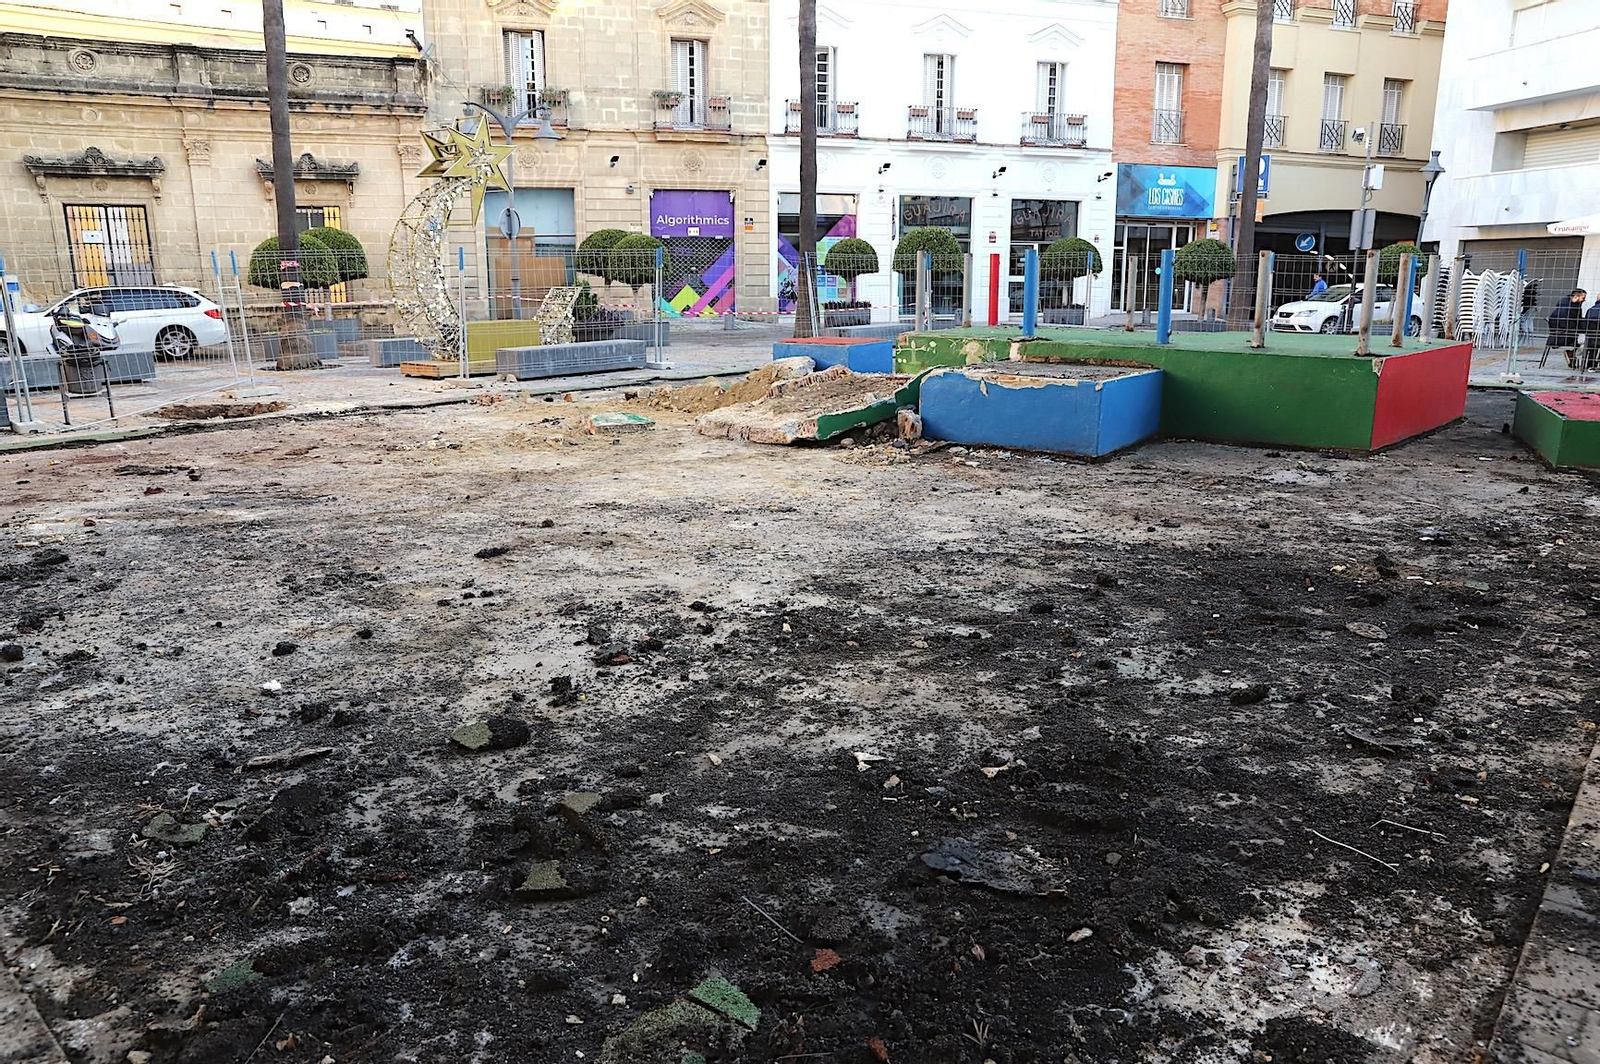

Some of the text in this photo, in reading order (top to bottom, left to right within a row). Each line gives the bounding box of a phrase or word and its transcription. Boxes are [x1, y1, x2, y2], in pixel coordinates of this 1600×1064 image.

[1148, 187, 1184, 206] LOS CISNES
[656, 215, 730, 226] Algorithmics
[903, 202, 966, 223] GUAJIRA
[1013, 206, 1072, 225] GUAJIRA
[1028, 229, 1060, 238] TATTOO
